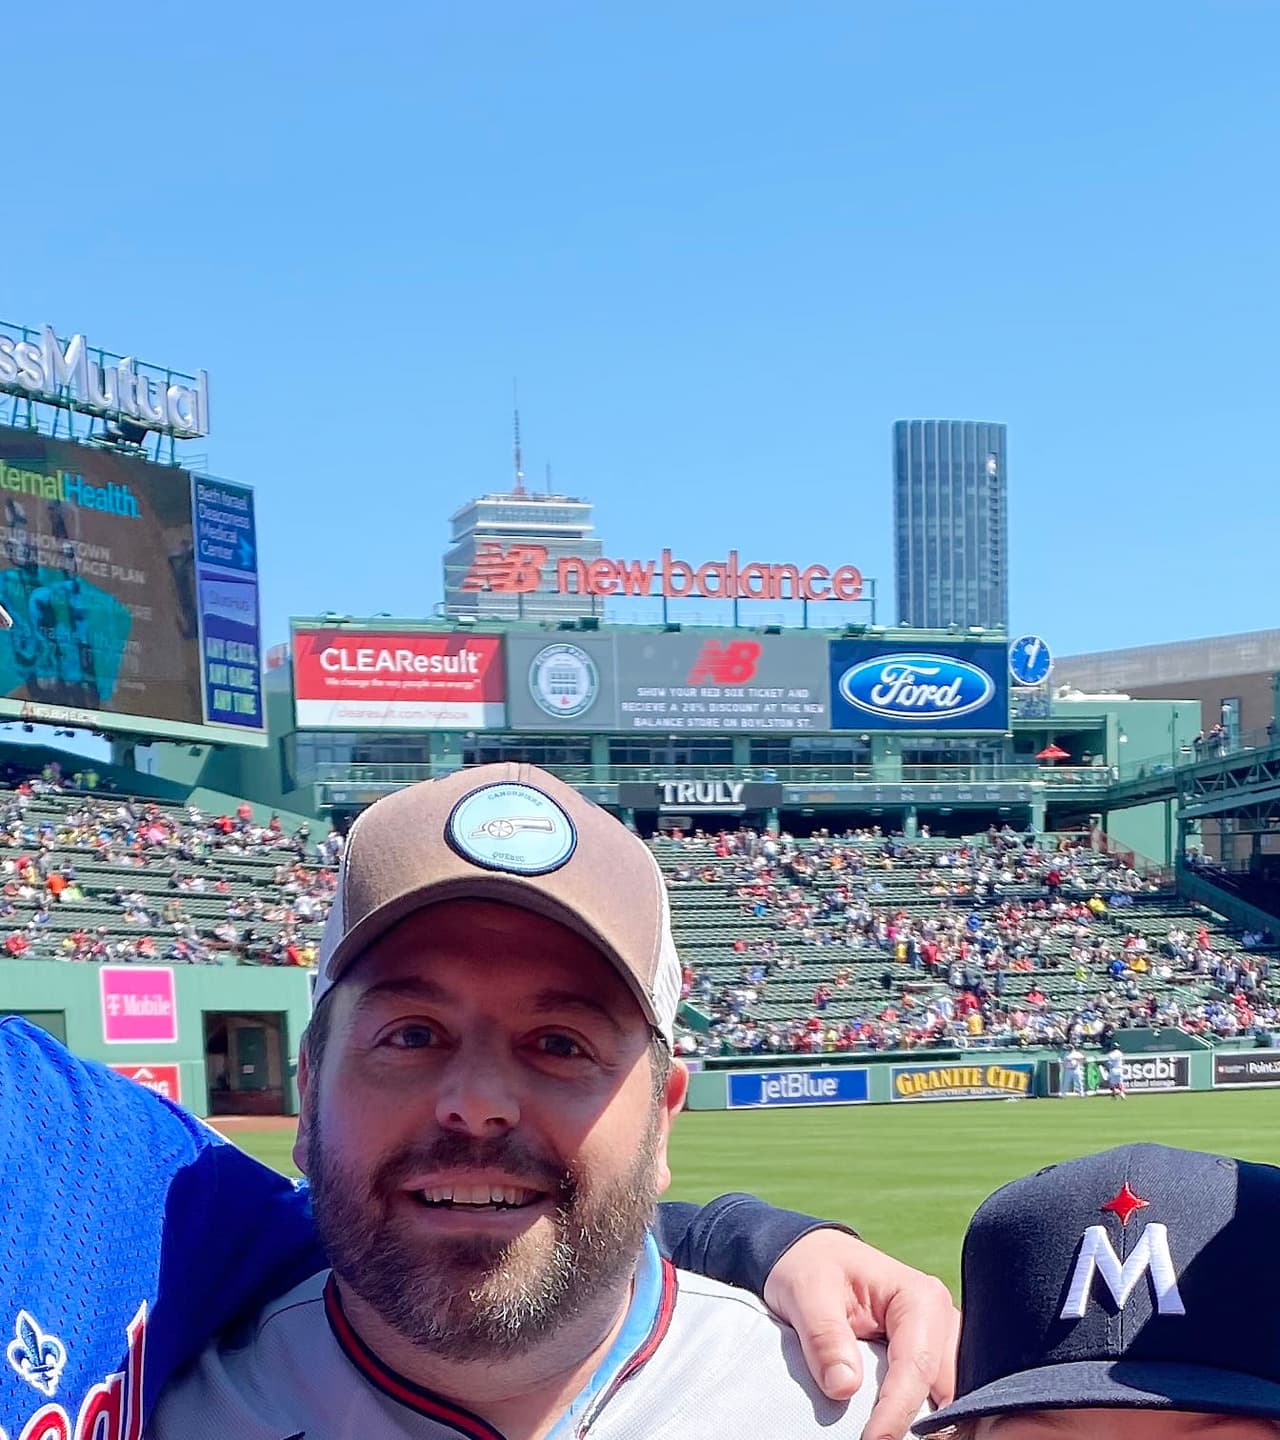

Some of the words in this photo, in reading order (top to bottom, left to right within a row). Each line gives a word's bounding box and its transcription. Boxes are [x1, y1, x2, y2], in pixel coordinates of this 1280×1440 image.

[320, 648, 479, 673] CLEAResult
[637, 687, 665, 698] SHOW
[669, 687, 697, 698] YOUR
[701, 687, 720, 698] RED
[724, 688, 744, 698] SOX
[749, 688, 784, 698] TICKET
[788, 688, 809, 698] AND
[871, 663, 963, 706] Ford
[670, 703, 678, 712] A
[709, 703, 759, 713] DISCOUNT
[764, 703, 777, 713] AT
[781, 703, 801, 713] THE
[805, 703, 824, 713] NEW
[633, 717, 683, 727] BALANCE
[687, 717, 719, 727] STORE
[723, 718, 737, 727] ON
[741, 718, 794, 728] BOYLSTON
[658, 780, 744, 804] TRULY
[122, 993, 170, 1016] Mobile
[761, 1073, 837, 1102] jetBlue
[896, 1067, 982, 1095] GRANITE
[986, 1065, 1030, 1090] CITY
[1059, 1222, 1186, 1319] M
